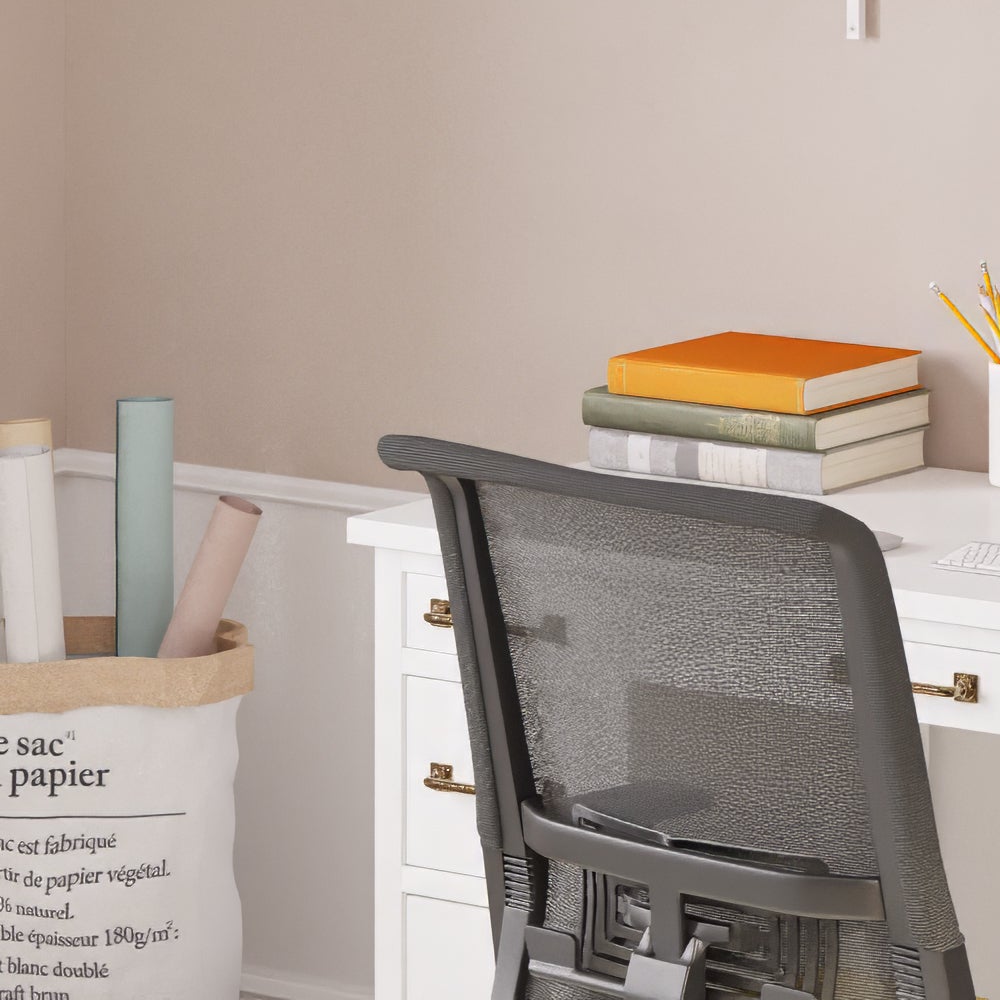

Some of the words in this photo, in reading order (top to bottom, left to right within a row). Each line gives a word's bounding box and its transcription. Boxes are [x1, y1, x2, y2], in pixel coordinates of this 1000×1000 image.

[16, 736, 64, 756] sac
[8, 760, 110, 797] papier
[18, 839, 40, 855] est
[44, 833, 117, 854] fabriqué
[23, 871, 42, 888] de
[45, 866, 103, 895] papier
[28, 926, 99, 949] épaisseur
[8, 957, 48, 976] blanc
[53, 960, 110, 979] doublé
